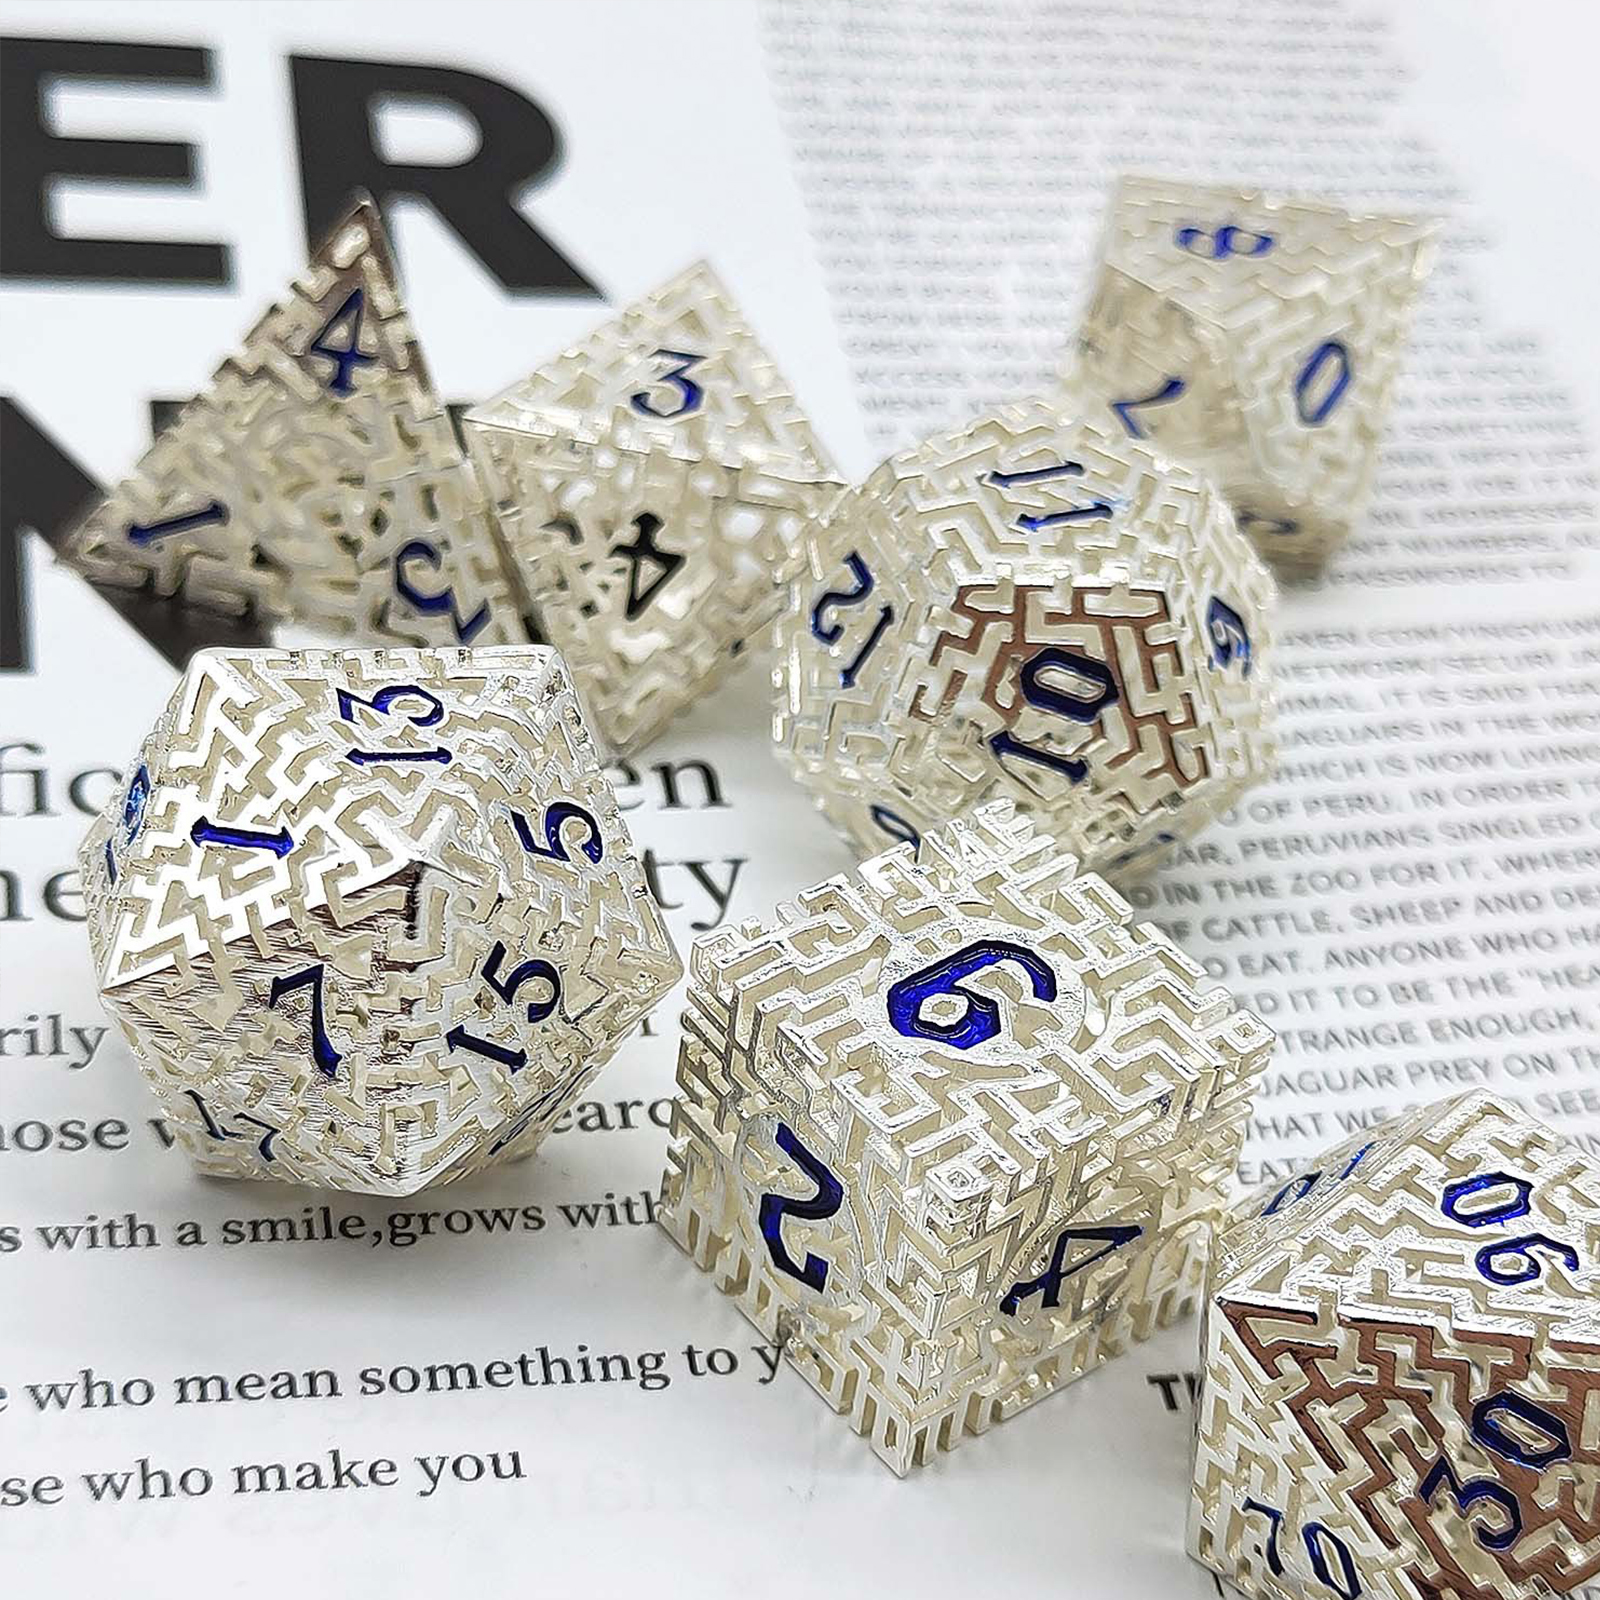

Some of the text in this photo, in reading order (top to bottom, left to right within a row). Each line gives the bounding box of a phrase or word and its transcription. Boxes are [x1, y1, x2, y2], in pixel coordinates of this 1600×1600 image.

[310, 288, 378, 397] 4
[630, 349, 708, 418] 3
[1294, 340, 1355, 426] 0
[608, 512, 687, 622] 4
[336, 685, 450, 766] 13
[987, 646, 1120, 785] 10
[190, 813, 294, 859] 1
[511, 800, 603, 866] 5
[1324, 935, 1466, 970] ANYONE
[1469, 926, 1561, 955] WHO
[1445, 969, 1514, 1000] THE
[269, 963, 343, 1077] 7
[446, 941, 564, 1074] 15
[886, 938, 1059, 1050] 6
[1261, 1063, 1399, 1098] JAGUAR
[1403, 1055, 1492, 1087] PREY
[1501, 1050, 1559, 1080] ON
[37, 1213, 160, 1250] with
[176, 1219, 208, 1246] a
[757, 1121, 844, 1294] 2
[1001, 1224, 1143, 1316] 4
[25, 1368, 156, 1412] who
[173, 1366, 343, 1404] mean
[359, 1344, 683, 1396] something
[686, 1343, 738, 1377] to
[82, 1456, 214, 1501] who
[231, 1449, 399, 1495] make
[416, 1450, 527, 1496] you
[1419, 1391, 1573, 1550] 30
